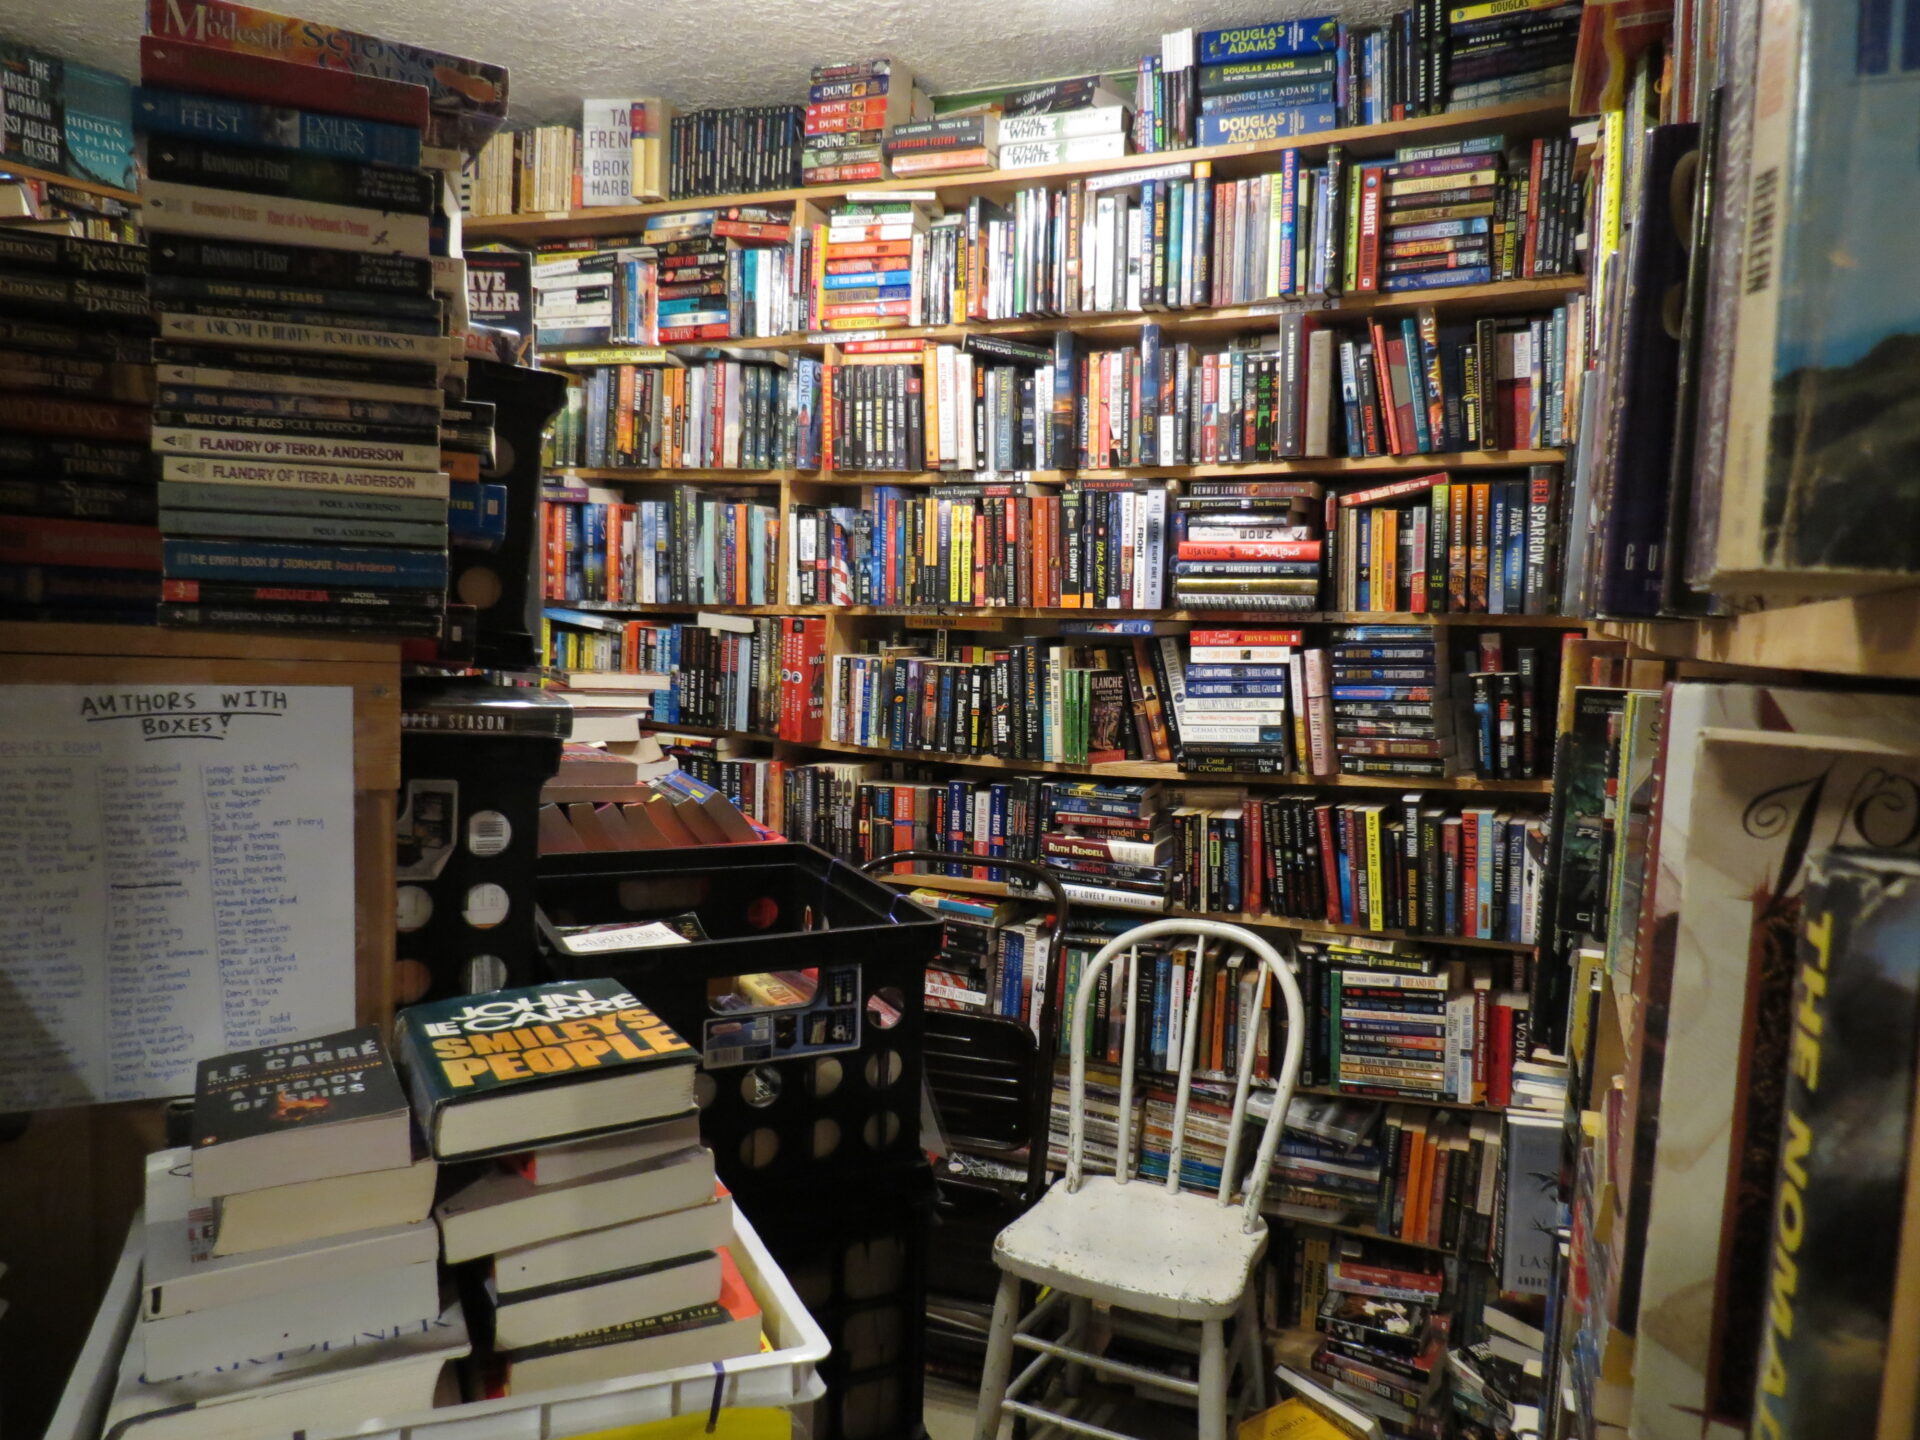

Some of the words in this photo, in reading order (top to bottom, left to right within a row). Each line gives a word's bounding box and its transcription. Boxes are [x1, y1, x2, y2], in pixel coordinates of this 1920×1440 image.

[301, 22, 405, 60] SCION
[1220, 25, 1285, 43] DOUGLAS
[1468, 33, 1500, 44] MOSTLY
[1521, 21, 1564, 34] HARMLESS
[1228, 37, 1276, 55] ADAMS
[28, 58, 50, 81] THE
[1223, 64, 1262, 75] DOUGLAS
[1265, 61, 1294, 71] ADAMS
[823, 83, 851, 96] DUNE
[1226, 89, 1275, 104] DOUGLAS
[1279, 84, 1315, 97] ADAMS
[5, 91, 51, 120] WOMAN
[821, 103, 847, 114] DUNE
[65, 115, 124, 138] HIDDEN
[180, 109, 241, 134] FEIST
[611, 109, 631, 127] TA
[819, 117, 845, 129] DUNE
[895, 127, 908, 135] LISA
[938, 122, 956, 131] TOUCH
[1004, 117, 1042, 130] LETHAL
[1219, 111, 1285, 132] DOUGLAS
[23, 120, 63, 142] ADLER-
[65, 129, 82, 142] IN
[84, 135, 127, 153] PLAIN
[1009, 126, 1047, 139] WHITE
[1227, 126, 1276, 143] ADAMS
[22, 139, 60, 164] OLSEN
[305, 132, 366, 154] RETURN
[817, 136, 846, 149] DUNE
[1007, 143, 1045, 156] LETHAL
[1406, 149, 1434, 160] HEATHER
[1434, 145, 1461, 157] GRAHAM
[75, 147, 118, 166] SIGHT
[1012, 152, 1050, 165] WHITE
[592, 179, 631, 197] HARB
[1364, 192, 1378, 237] PARASITE
[1746, 167, 1778, 297] HEINLEIN
[208, 285, 242, 296] TIME
[244, 288, 276, 300] AND
[281, 291, 324, 305] STARS
[1422, 318, 1436, 353] STILL
[801, 365, 811, 402] GONE
[824, 368, 832, 454] SUPERMARKET
[184, 412, 216, 425] VAULT
[218, 415, 235, 426] OF
[237, 416, 256, 427] THE
[257, 417, 284, 429] AGES
[316, 422, 367, 435] ANDERSON
[200, 438, 260, 454] FLANDRY
[265, 440, 282, 455] OF
[213, 465, 273, 481] FLANDRY
[278, 468, 294, 483] OF
[934, 488, 952, 497] Laura
[953, 488, 980, 497] Lippman
[1193, 486, 1218, 495] DENNIS
[1221, 485, 1247, 494] LEHANE
[1532, 479, 1549, 504] RED
[1494, 503, 1503, 547] BLOWBACK
[1509, 508, 1517, 537] FRAME
[1069, 532, 1079, 546] THE
[1433, 514, 1441, 559] MACKINTOSH
[1453, 515, 1461, 560] MACKINTOSH
[1475, 515, 1483, 560] MACKINTOSH
[1529, 505, 1548, 565] SPARROW
[209, 555, 239, 567] EARTH
[241, 557, 268, 568] BOOK
[270, 558, 281, 568] OF
[283, 558, 333, 571] STORMGATE
[358, 561, 397, 573] Anderson
[1069, 547, 1079, 584] COMPANY
[1190, 564, 1203, 573] SAVE
[1204, 564, 1214, 572] ME
[1225, 564, 1262, 573] DANGEROUS
[1263, 564, 1277, 573] MEN
[1492, 550, 1500, 575] PETER
[1512, 547, 1520, 570] PETER
[1490, 577, 1499, 593] MAY
[1027, 646, 1035, 677] LYING
[1027, 680, 1036, 704] WAIT
[1091, 676, 1123, 689] BLANCHE
[222, 691, 287, 709] WITH
[401, 712, 440, 729] OPEN
[448, 713, 505, 731] SEASON
[998, 714, 1007, 742] EIGHT
[1198, 764, 1232, 773] O'Connell
[1206, 757, 1225, 766] Carol
[1257, 759, 1274, 767] Find
[1406, 808, 1417, 840] INFINITY
[1465, 817, 1476, 839] RIP
[1049, 843, 1071, 855] RUTH
[1071, 845, 1105, 858] RENDELL
[1406, 841, 1417, 858] BORN
[1464, 847, 1476, 870] TIDE
[1511, 836, 1523, 867] Stella
[1080, 888, 1105, 901] LOVELY
[1510, 867, 1522, 905] RIMINGTON
[1036, 982, 1046, 993] 44
[1100, 970, 1108, 992] WIRE
[450, 990, 595, 1022] JOHN
[1793, 912, 1832, 1091] THE
[424, 1021, 461, 1037] LE
[432, 1009, 667, 1060] SMILEYS
[208, 1064, 247, 1082] LE
[266, 1039, 379, 1071] CARRÉ
[263, 1041, 323, 1058] JOHN
[441, 1026, 691, 1088] PEOPLE
[230, 1091, 246, 1101] A
[259, 1072, 364, 1096] LEGACY
[233, 1098, 269, 1112] OF
[616, 1318, 657, 1332] FROM
[662, 1313, 685, 1324] MY
[690, 1307, 720, 1319] LIFE
